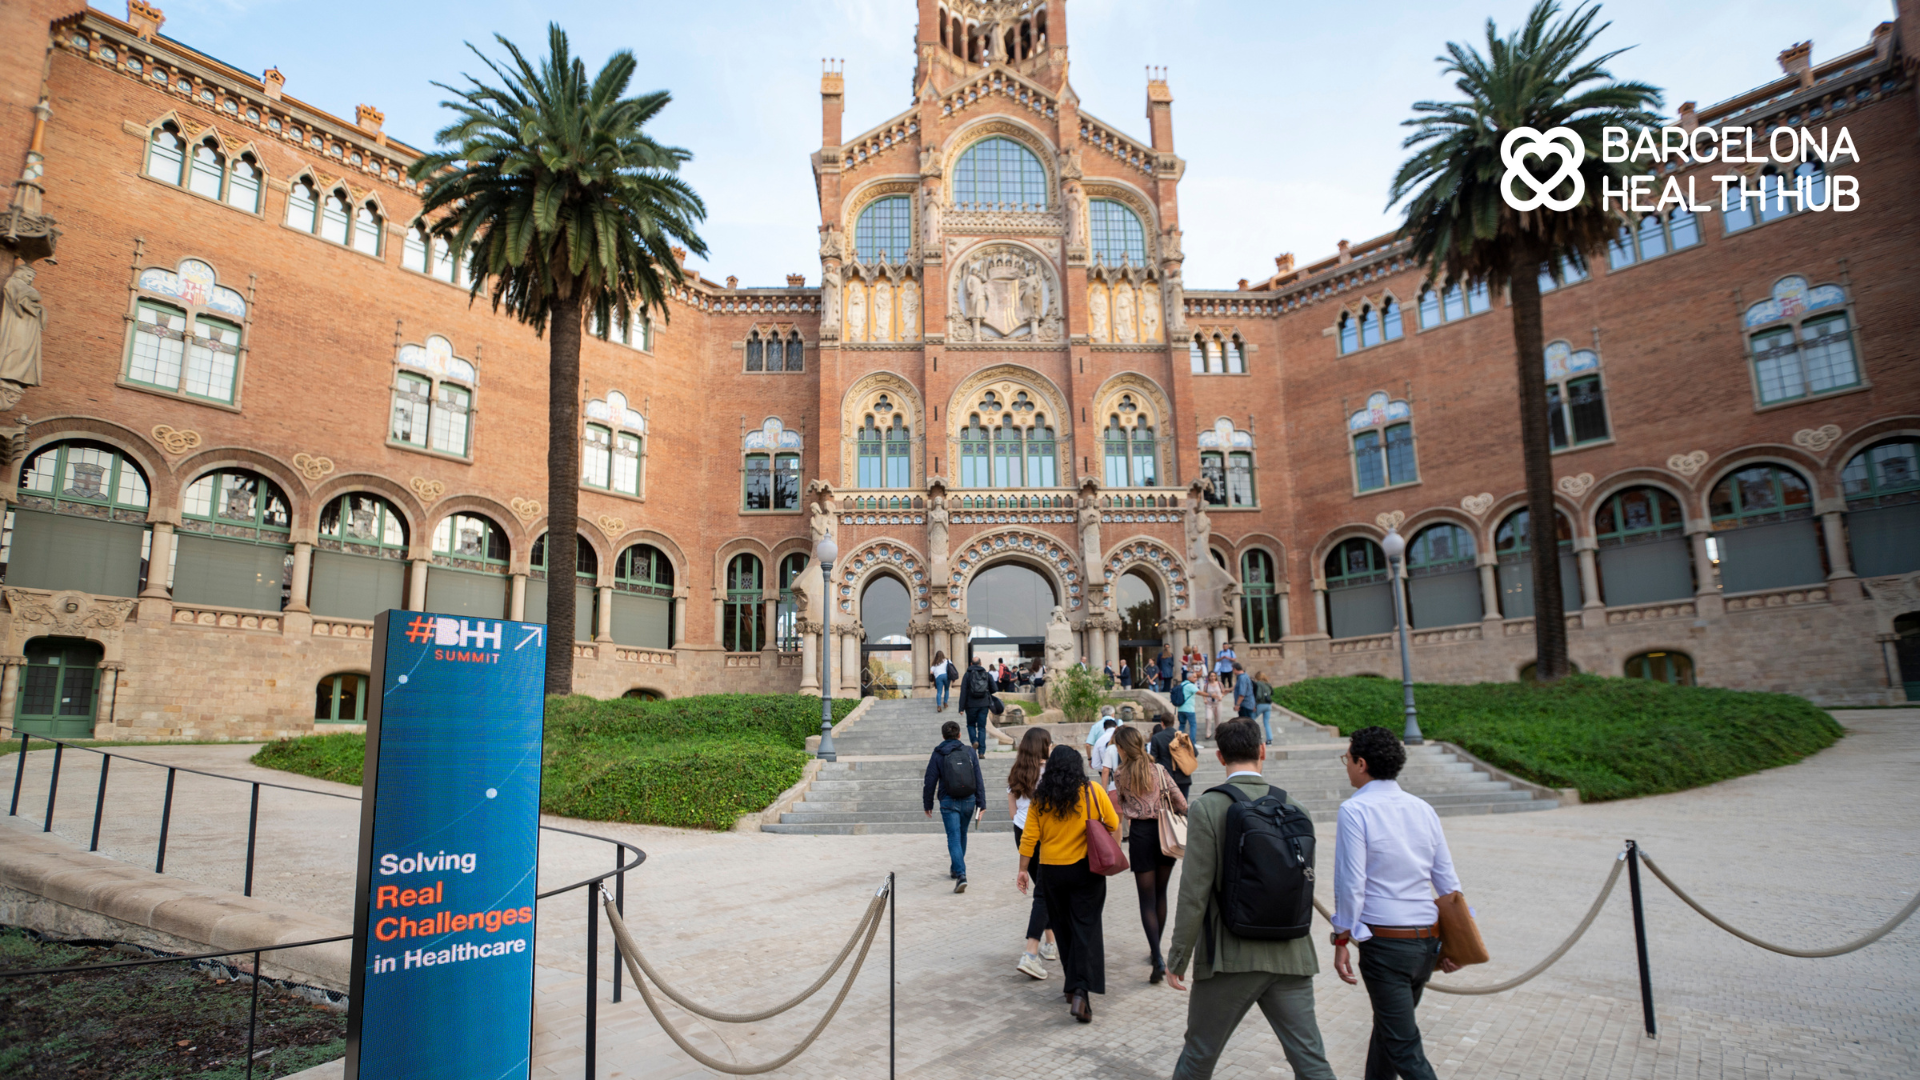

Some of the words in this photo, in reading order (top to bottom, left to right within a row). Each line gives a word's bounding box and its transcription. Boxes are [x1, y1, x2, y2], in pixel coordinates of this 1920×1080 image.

[435, 649, 500, 664] SUMMIT
[379, 850, 476, 876] Solving
[376, 880, 443, 910] Real
[375, 906, 533, 942] Challenges
[373, 954, 396, 974] in
[404, 938, 526, 970] Healthcare
